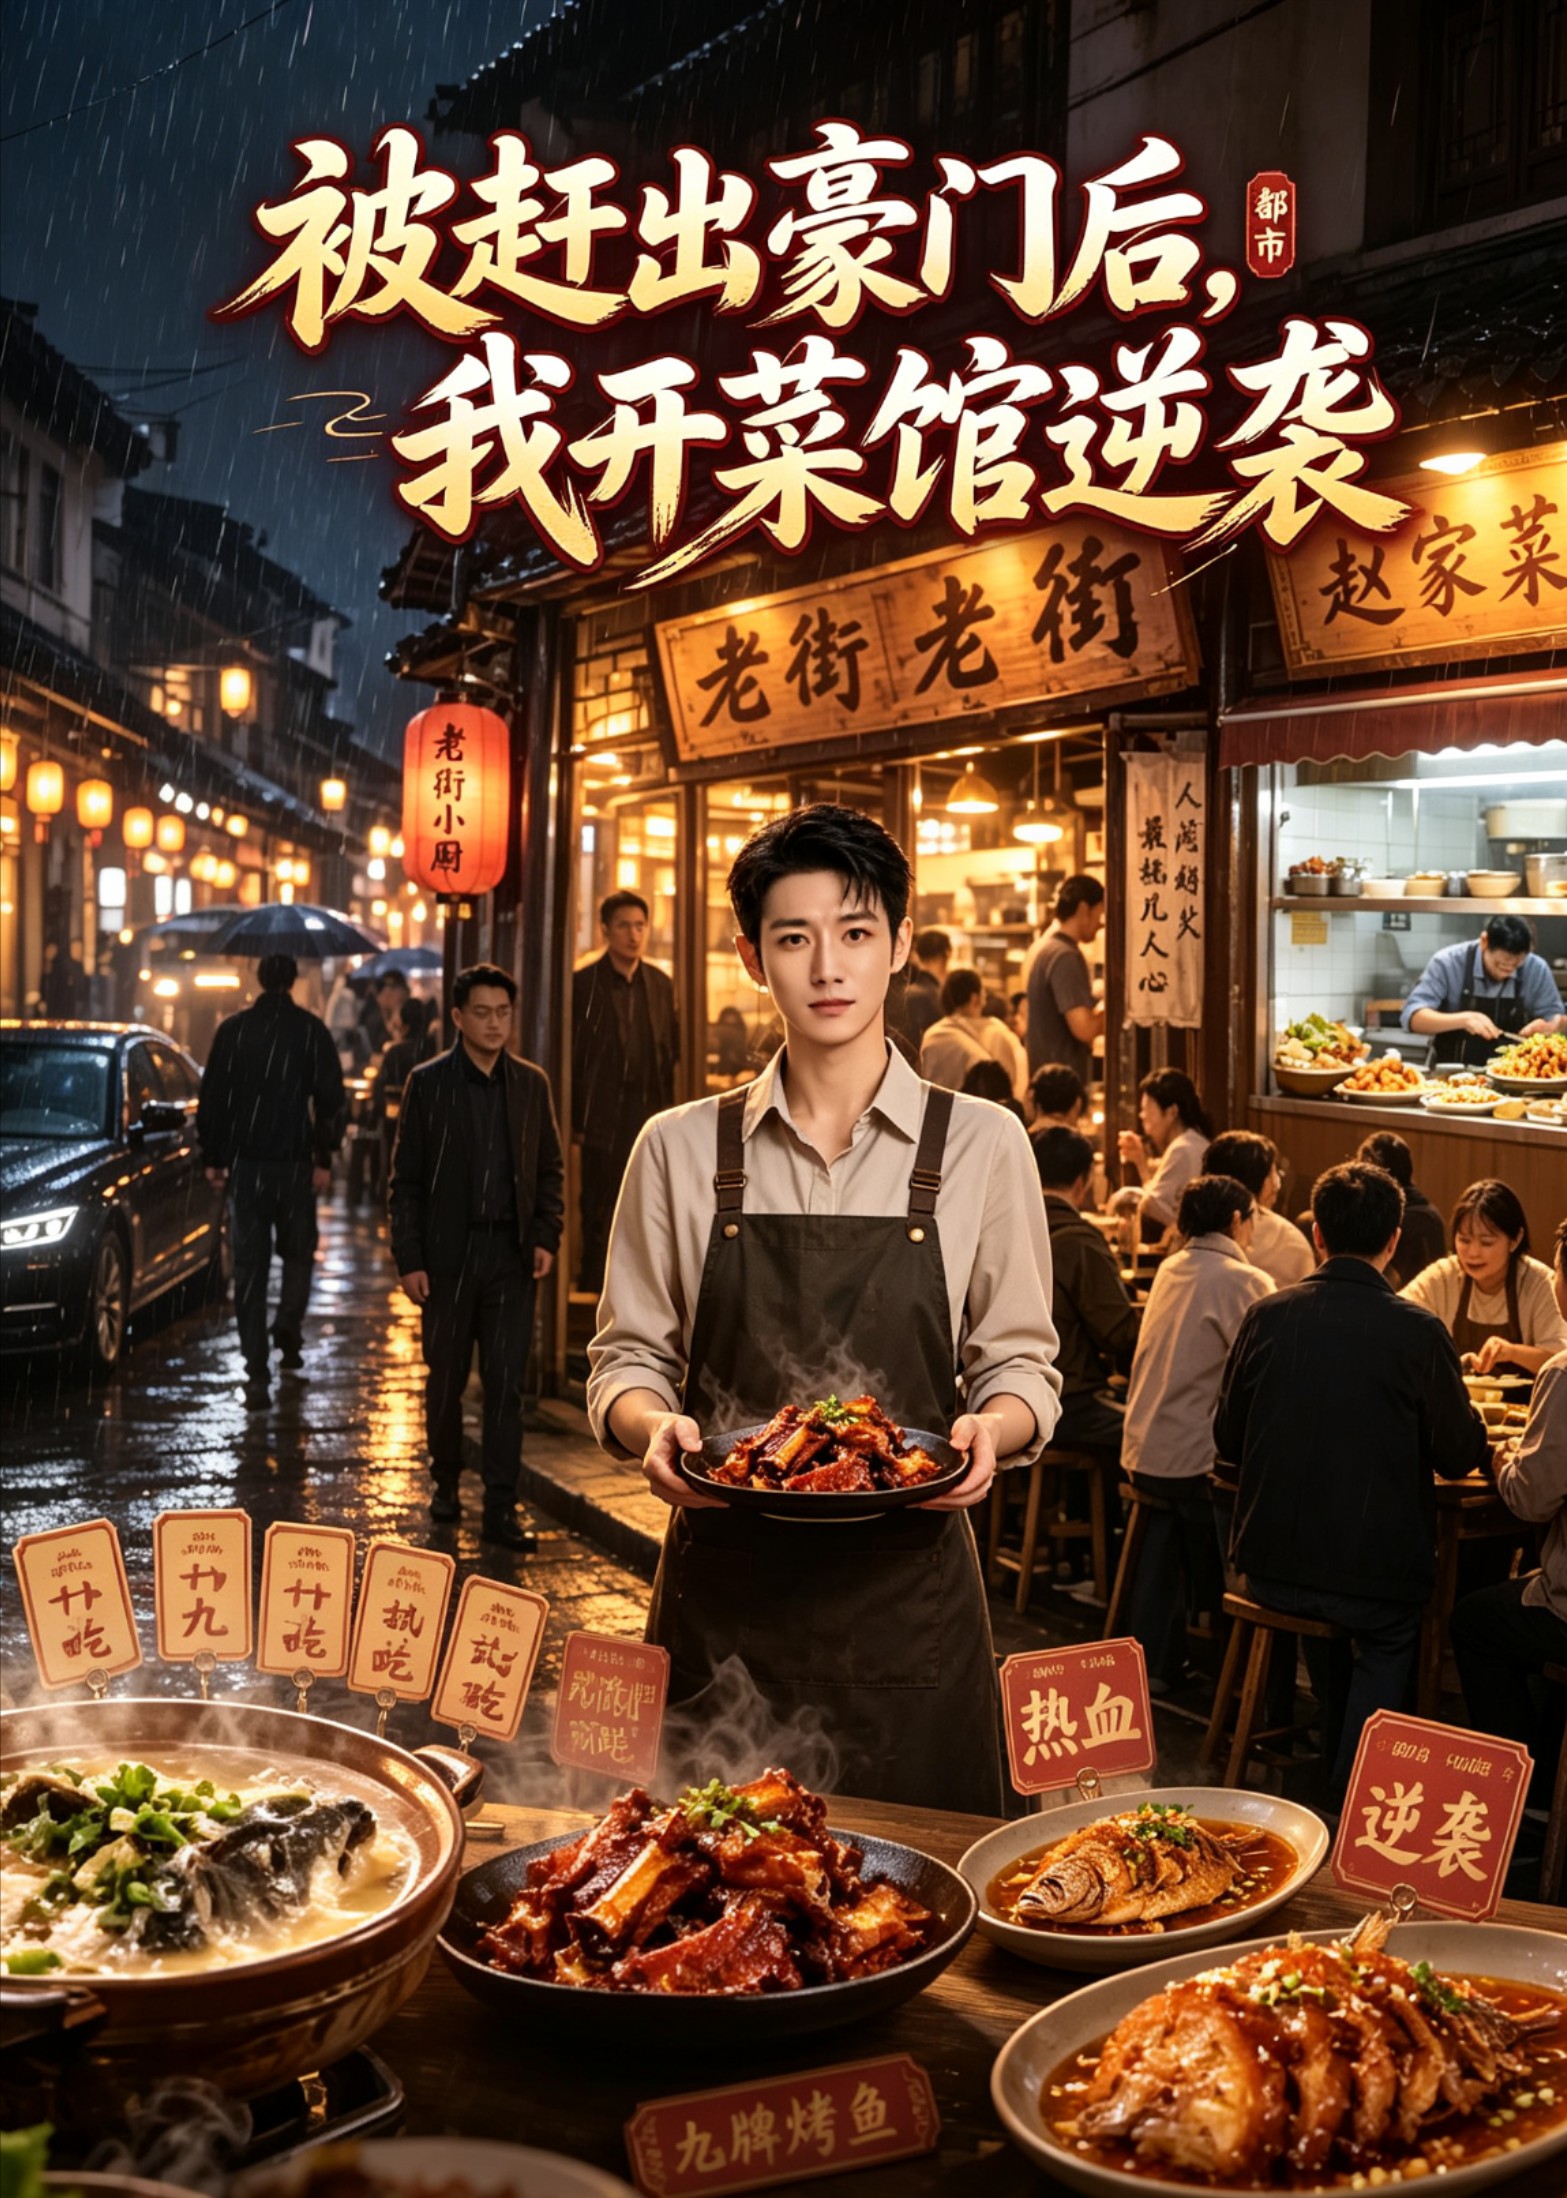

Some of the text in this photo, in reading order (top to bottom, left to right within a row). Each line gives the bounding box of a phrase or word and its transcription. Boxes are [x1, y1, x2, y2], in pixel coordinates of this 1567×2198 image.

[1317, 493, 1567, 626] 赵家菜
[696, 535, 1142, 728] 老街老街
[1020, 1681, 1142, 1767] 热血
[1354, 1781, 1493, 1883] 逆袭
[675, 2081, 898, 2175] 九牌烤鱼
